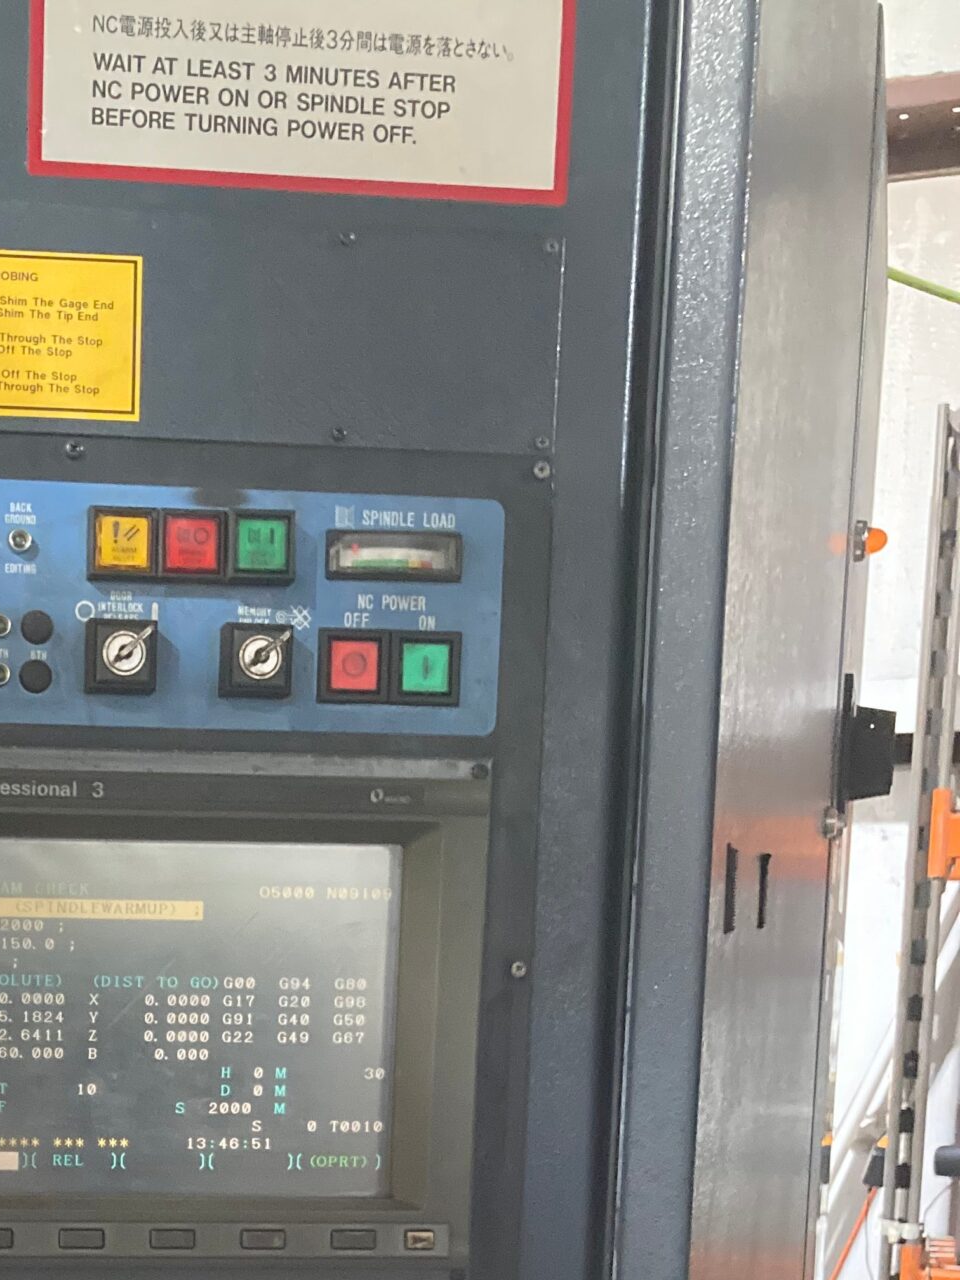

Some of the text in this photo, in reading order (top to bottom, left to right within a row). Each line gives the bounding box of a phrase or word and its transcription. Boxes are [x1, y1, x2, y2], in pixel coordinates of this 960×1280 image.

[93, 52, 456, 93] WAIT AT LEAST 3 MINUTES AFTER
[92, 80, 451, 119] NC POWER ON OR SPINDLE STOP
[91, 108, 417, 145] BEFORE TURNING POWER OFF.
[0, 296, 28, 306] Shim
[32, 297, 54, 307] The
[59, 298, 89, 311] Gage
[93, 300, 115, 310] End
[29, 309, 51, 319] The
[56, 311, 74, 323] Tip
[77, 312, 99, 322] End
[0, 332, 46, 346] Through
[52, 335, 73, 345] The
[77, 335, 103, 347] Stop
[20, 345, 42, 356] The
[46, 346, 73, 358] Stop
[1, 369, 20, 379] Off
[25, 370, 47, 381] The
[51, 371, 78, 383] Stop
[48, 383, 70, 394] The
[74, 384, 100, 396] Stop
[361, 509, 456, 529] SPINDLE LOAD
[4, 563, 37, 575] EDITING
[357, 593, 427, 613] NC POWER
[343, 612, 370, 630] OFF
[418, 615, 436, 631] ON
[92, 781, 105, 798] 3
[93, 976, 256, 990] (DIST TO GO) G00
[222, 1012, 254, 1025] G91
[277, 1013, 310, 1026] G40
[333, 1013, 366, 1027] G50
[221, 1030, 254, 1043] G22
[277, 1031, 310, 1044] G49
[332, 1031, 365, 1044] G67
[208, 1102, 252, 1115] 2000
[329, 1120, 383, 1133] T0010
[187, 1137, 271, 1150] 13:46:51
[52, 1154, 84, 1166] REL
